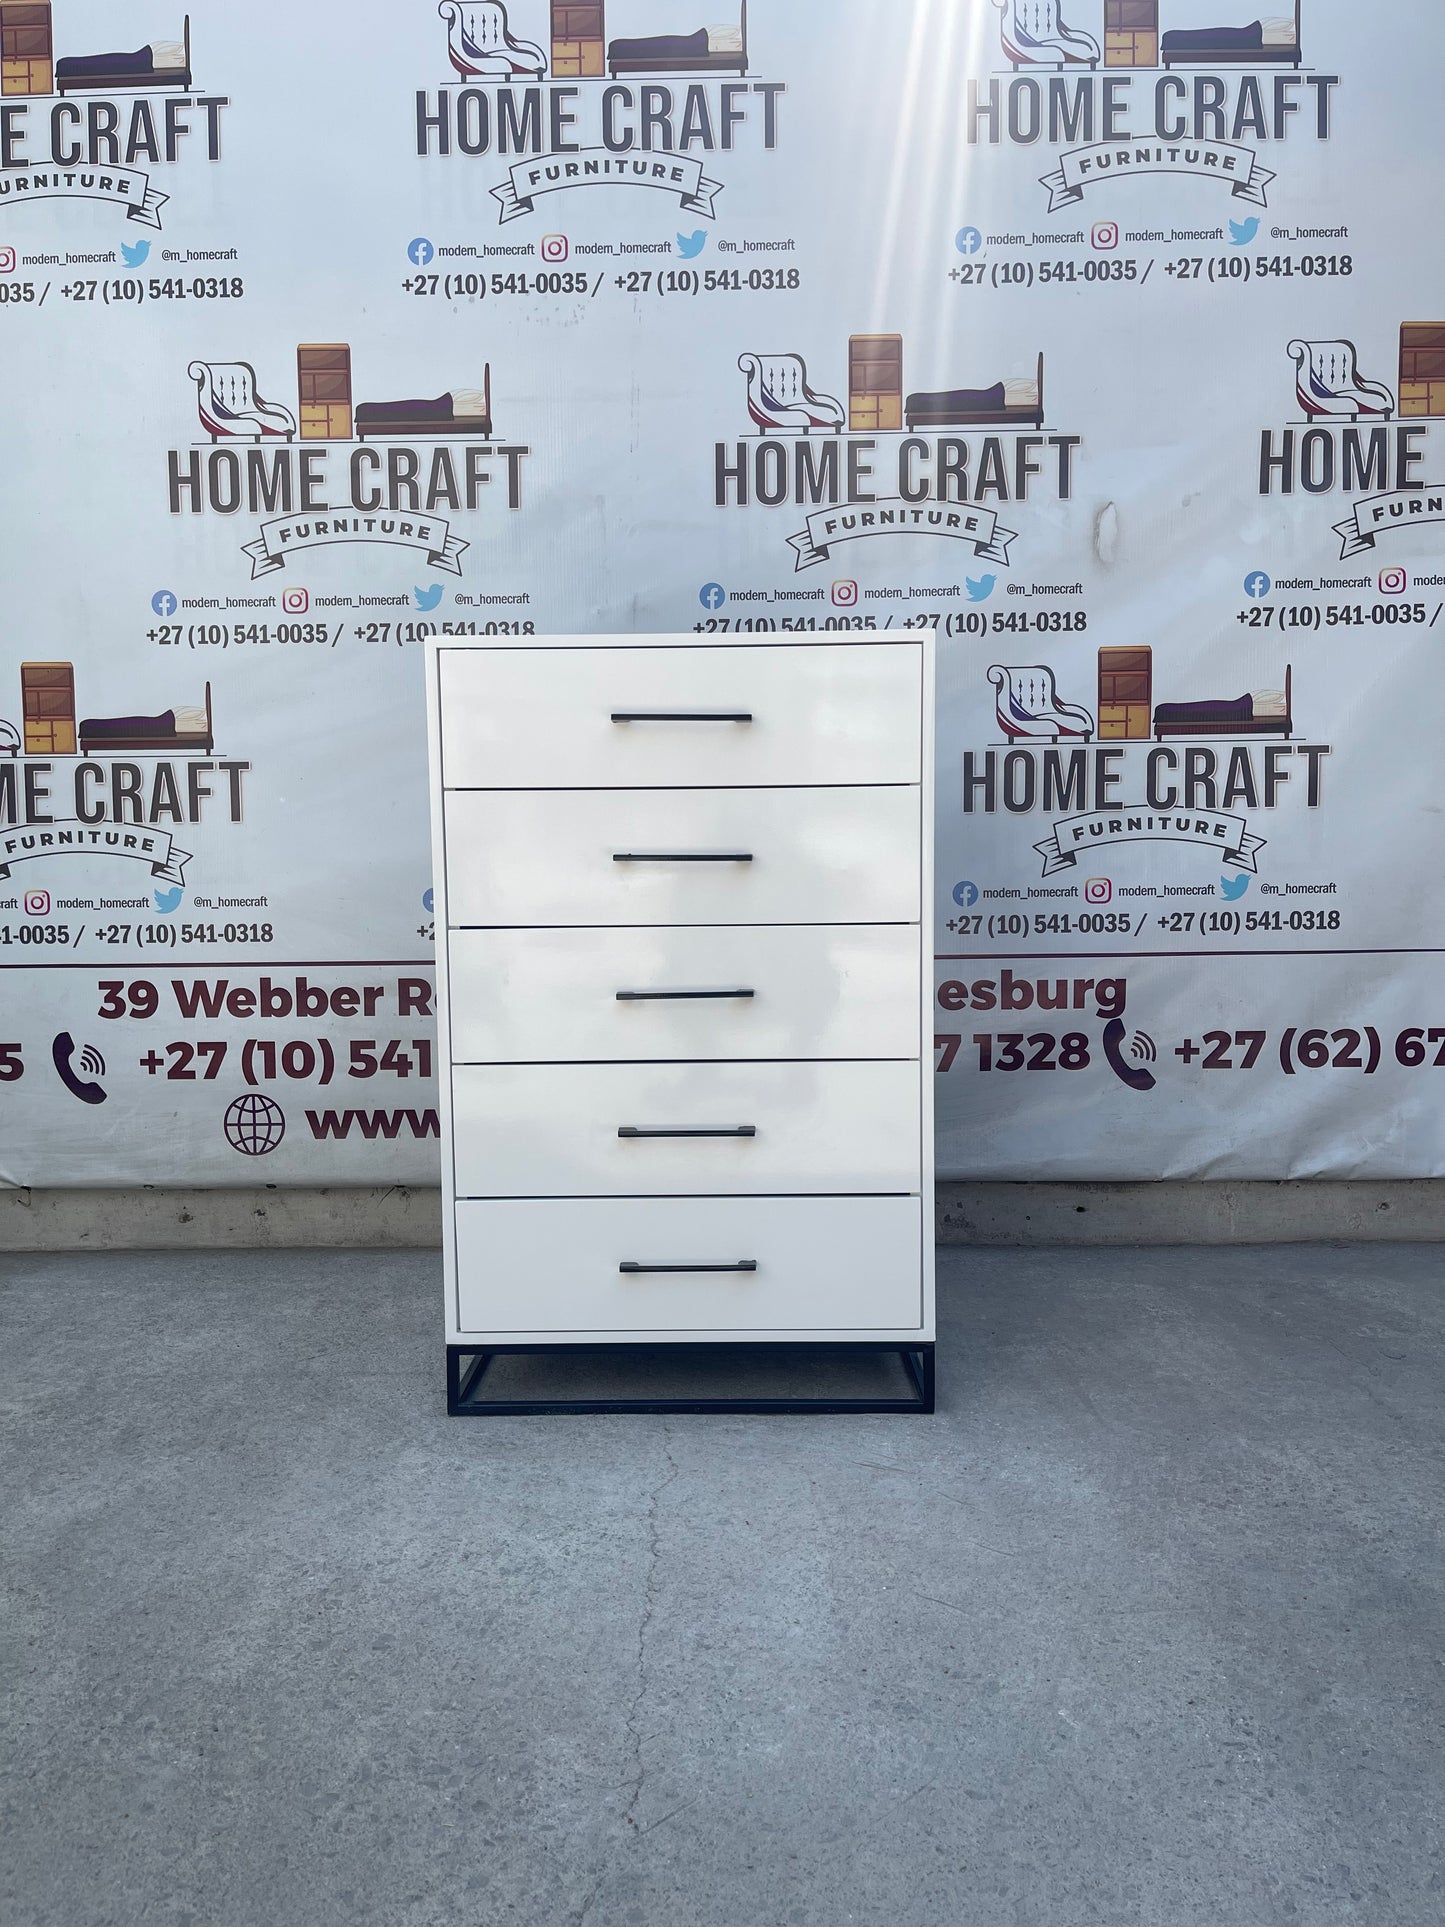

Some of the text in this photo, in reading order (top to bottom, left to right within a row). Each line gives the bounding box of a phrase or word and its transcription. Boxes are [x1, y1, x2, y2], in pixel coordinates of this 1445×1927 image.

[416, 83, 785, 155] HOME CRAFT
[967, 76, 1338, 143] HOME CRAFT
[50, 98, 228, 166] CRAFT
[530, 159, 684, 185] FURNITURE
[1080, 148, 1237, 174] FURNITURE
[718, 239, 795, 253] @m_homecraft
[1271, 226, 1348, 240] @m_homecraft
[162, 248, 238, 262] @m_homecraft
[402, 275, 439, 295] +27
[445, 274, 486, 299] (10)
[491, 273, 587, 294] 541-0035
[615, 272, 652, 292] +27
[658, 271, 698, 296] (10)
[704, 269, 799, 290] 541-0318
[949, 264, 986, 284] +27
[992, 263, 1033, 288] (10)
[1039, 260, 1136, 282] 541-0035
[1165, 258, 1202, 278] +27
[1208, 257, 1250, 282] (10)
[1256, 255, 1352, 277] 541-0318
[61, 281, 97, 300] +27
[103, 280, 143, 304] (10)
[149, 278, 243, 299] 541-0318
[715, 437, 1080, 506] HOME CRAFT
[1259, 426, 1426, 494] HOME
[168, 447, 529, 513] HOME CRAFT
[280, 519, 431, 543] FURNITURE
[825, 510, 978, 534] FURNITURE
[455, 593, 530, 606] @m_homecraft
[1007, 583, 1082, 596] @m_homecraft
[946, 613, 987, 637] (10)
[992, 612, 1086, 632] 541-0318
[1237, 607, 1274, 626] +27
[1279, 606, 1320, 631] (10)
[1326, 604, 1425, 625] 541-0035
[147, 626, 183, 644] +27
[189, 625, 228, 649] (10)
[234, 624, 327, 644] 541-0035
[354, 623, 390, 642] +27
[964, 745, 1329, 813] HOME CRAFT
[75, 761, 250, 824] CRAFT
[1072, 816, 1227, 841] FURNITURE
[5, 831, 154, 854] FURNITURE
[194, 896, 268, 909] @m_homecraft
[1261, 883, 1336, 896] @m_homecraft
[0, 925, 69, 944] 1-0035
[96, 925, 131, 943] +27
[137, 925, 176, 947] (10)
[181, 924, 273, 943] 541-0318
[946, 916, 983, 934] +27
[988, 915, 1029, 938] (10)
[1034, 914, 1130, 933] 541-0035
[1158, 913, 1195, 931] +27
[1200, 912, 1240, 935] (10)
[1246, 911, 1340, 930] 541-0318
[98, 977, 437, 1019] 39 Webber R
[935, 970, 1126, 1018] esburg
[140, 1042, 227, 1079] +27
[242, 1039, 334, 1085] (10)
[348, 1040, 431, 1078] 541
[973, 1032, 1090, 1071] 1328
[1175, 1031, 1266, 1069] +27
[1280, 1027, 1380, 1074] (62)
